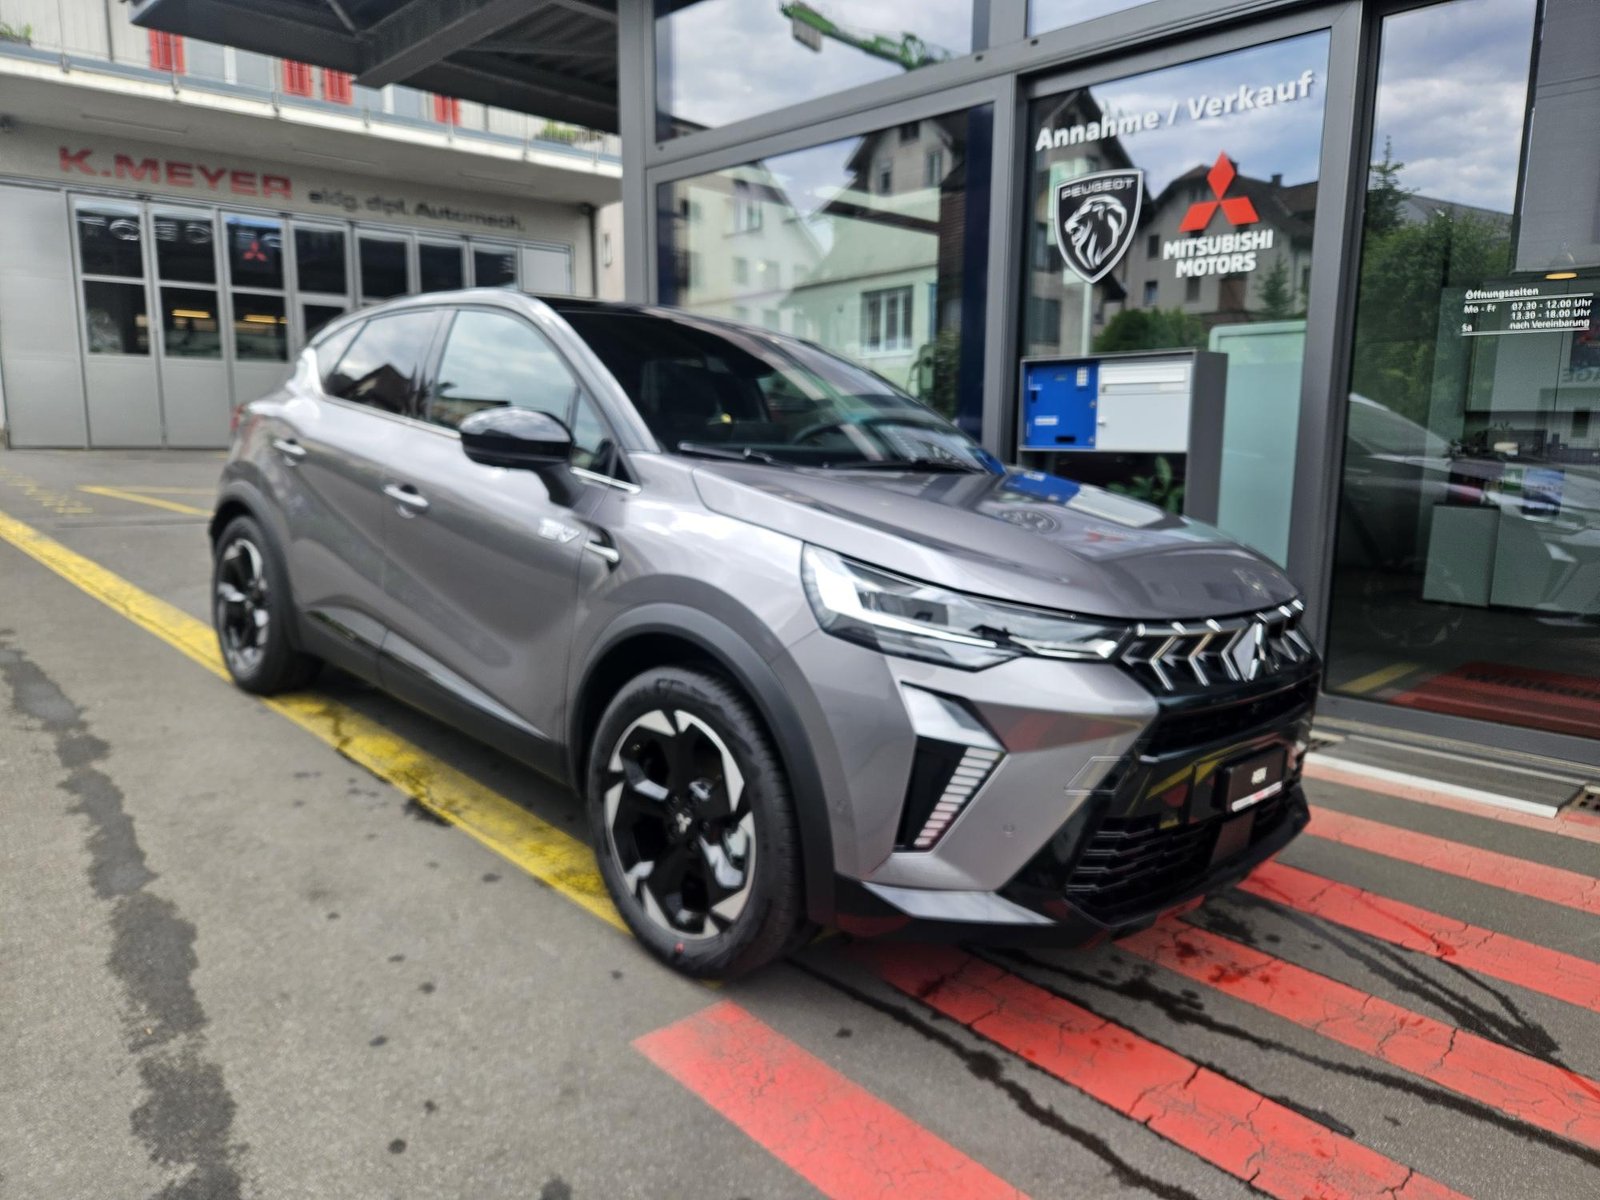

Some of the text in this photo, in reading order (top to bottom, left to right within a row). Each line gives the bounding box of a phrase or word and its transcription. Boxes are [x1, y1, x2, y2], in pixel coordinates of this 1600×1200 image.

[1035, 110, 1159, 151] Annahme
[1188, 69, 1315, 120] Verkauf
[1061, 176, 1136, 199] PEUGEOT
[1163, 229, 1274, 260] MITSUBISHI
[1175, 252, 1257, 278] MOTORS
[1464, 305, 1479, 314] Mo
[1546, 300, 1572, 309] 12.00
[1574, 298, 1592, 307] Uhr
[1573, 308, 1591, 317] Uhr
[1510, 319, 1530, 330] nach
[1532, 318, 1590, 329] Vereinbarung
